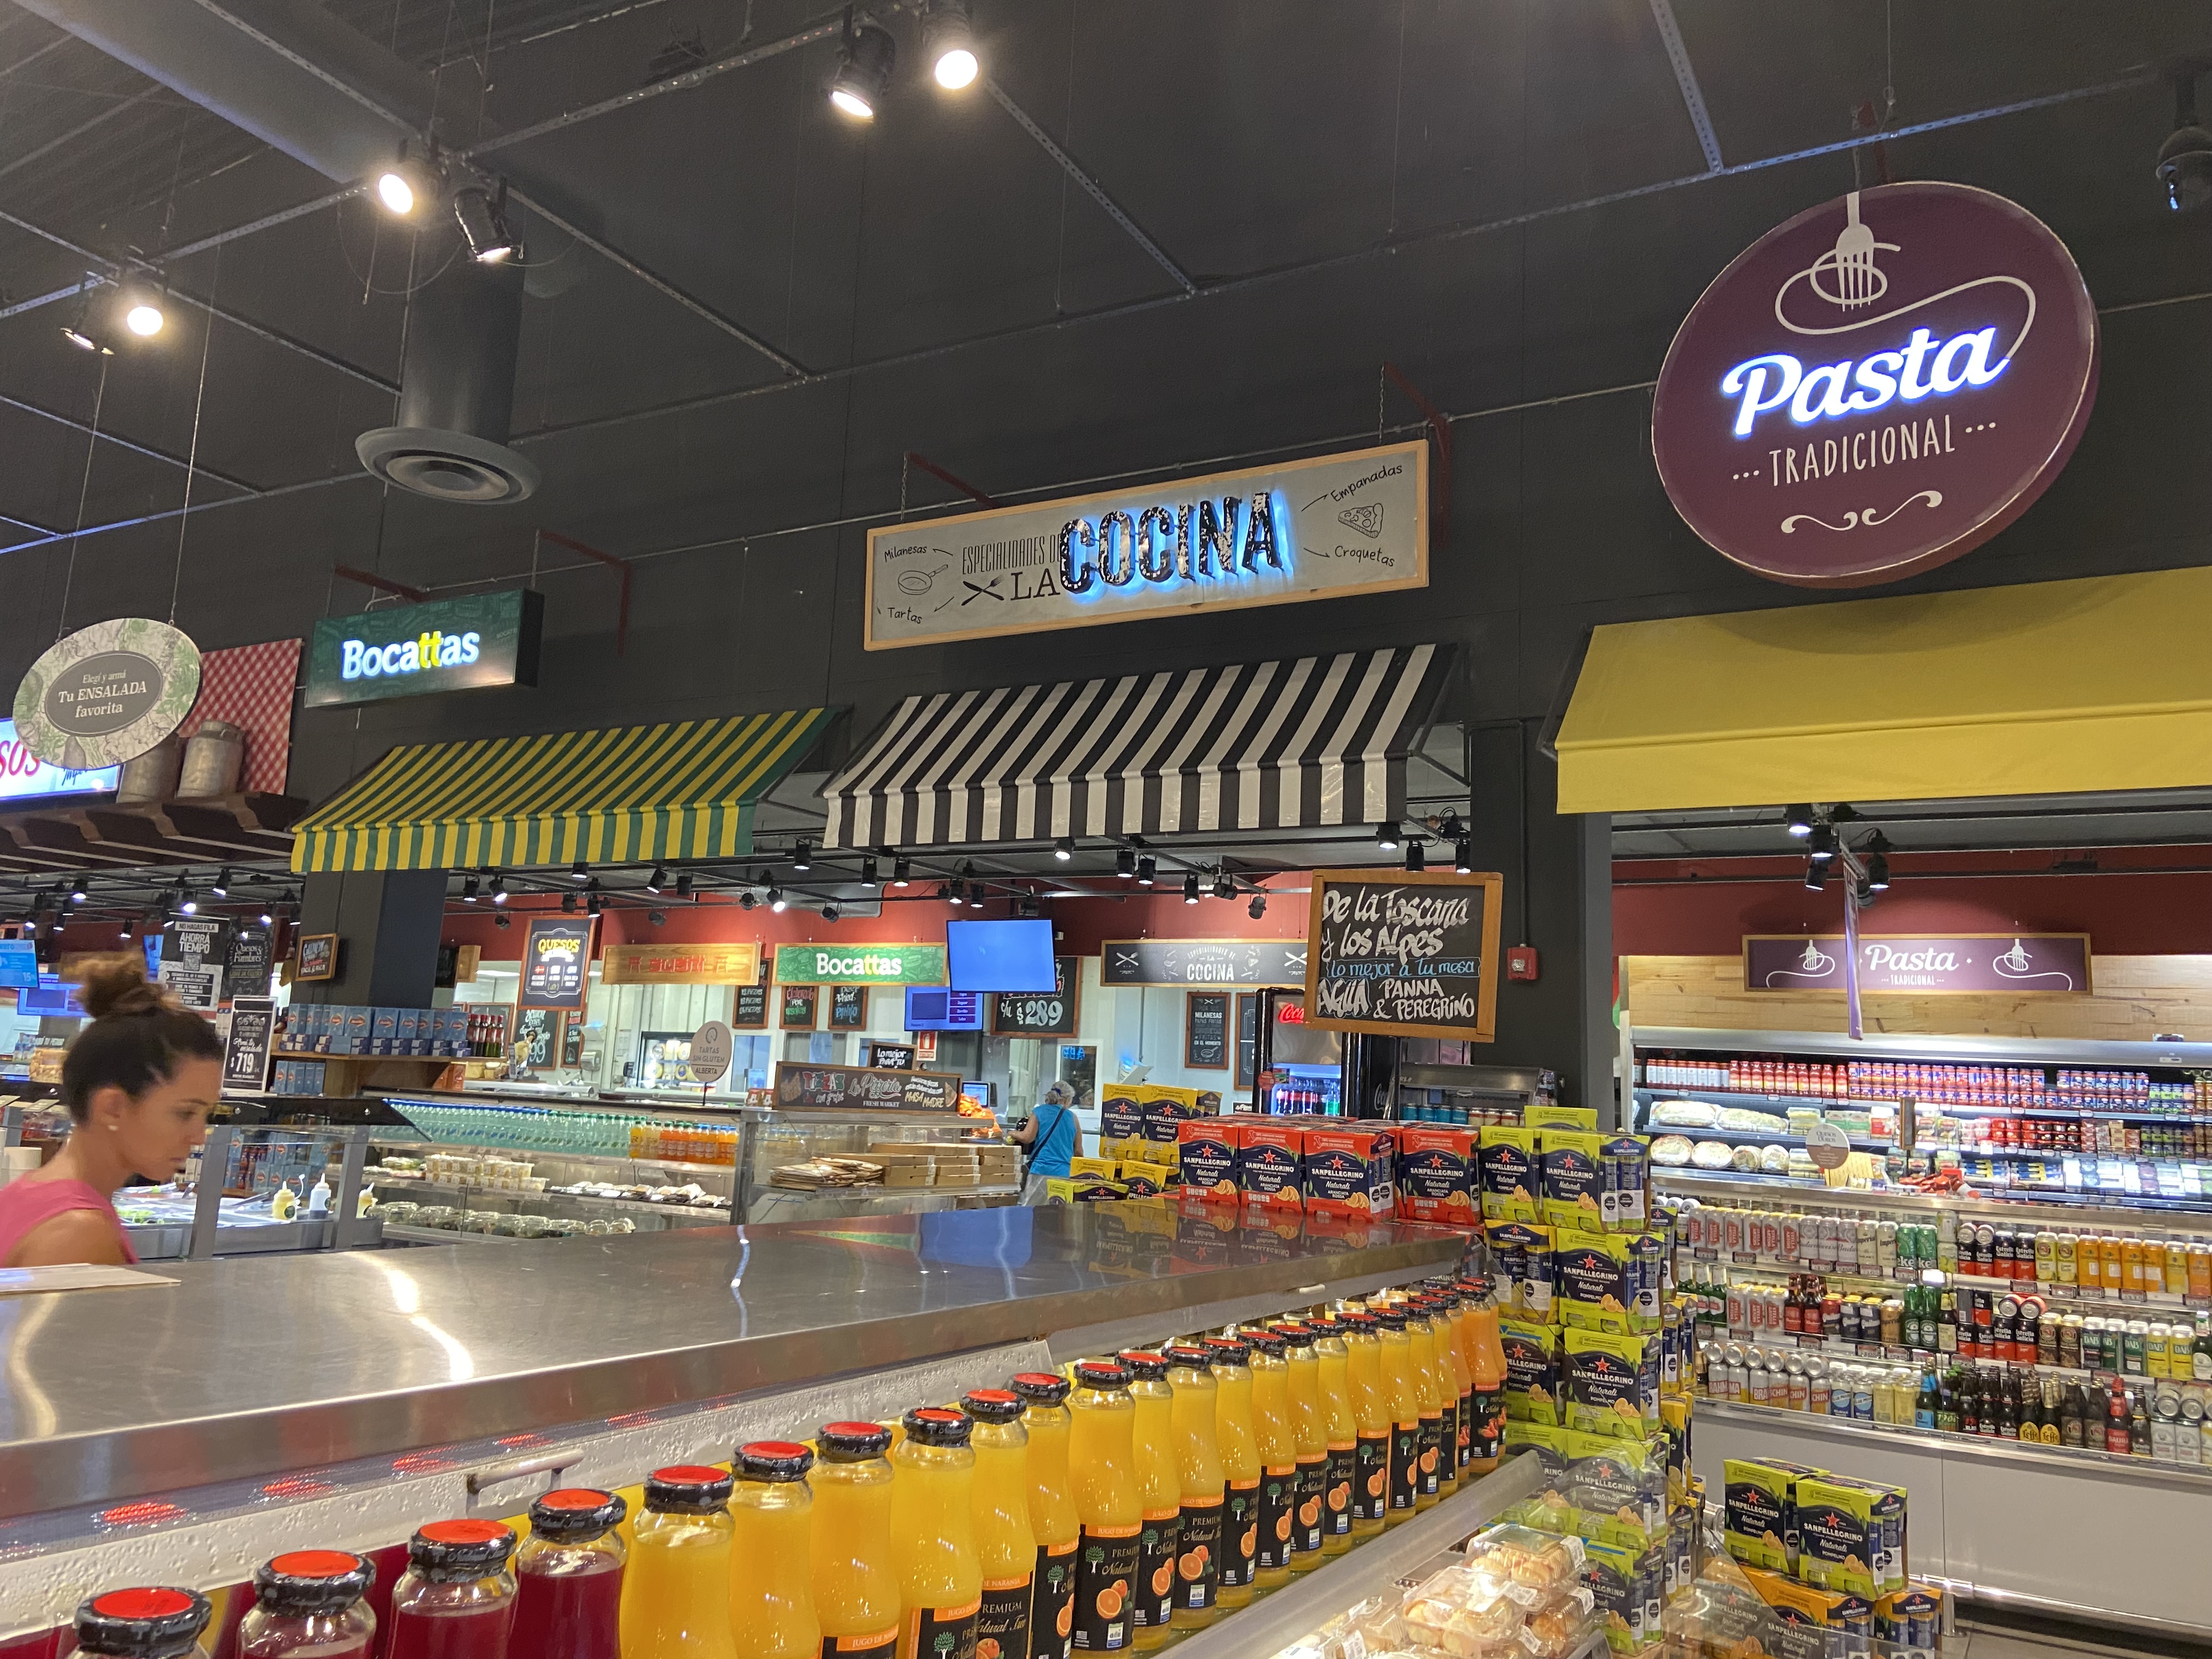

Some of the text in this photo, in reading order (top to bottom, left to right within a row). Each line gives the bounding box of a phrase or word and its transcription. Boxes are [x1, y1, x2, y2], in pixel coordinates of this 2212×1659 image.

[1723, 327, 2010, 436] Pasta
[1770, 414, 1955, 487] TRADICIONAL
[1330, 465, 1403, 502] Empanadas
[884, 546, 927, 562] Milanesas
[1011, 492, 1284, 601] LA COCINA
[963, 536, 1045, 575] ESPECIALIDADES
[1335, 545, 1395, 567] Croquetas
[887, 606, 922, 624] Tartas
[342, 630, 480, 679] Bocattas
[58, 681, 146, 703] Tu ENSALADA
[75, 703, 123, 718] favorita
[1322, 886, 1470, 929] De la Toscana
[179, 941, 210, 954] TIEMPO
[538, 939, 580, 954] QUESOS
[1187, 945, 1228, 959] ESPECIALIDADES
[1321, 923, 1444, 965] y los Alpes
[816, 952, 902, 976] Bocattas
[1865, 944, 1959, 971] Pasta
[1187, 963, 1234, 981] COCINA
[1350, 962, 1395, 980] mejor
[1399, 964, 1412, 976] a
[1438, 961, 1475, 974] mesa
[1891, 974, 1936, 985] TRADICIONAL
[1317, 979, 1444, 1019] AGUA PANNA
[1373, 1001, 1392, 1019] &
[230, 1052, 255, 1073] $ 719
[905, 1091, 945, 1108] MASA MADRE
[1104, 1112, 1141, 1121] SANPELLEGRINO
[1183, 1156, 1231, 1166] SANPELLEGRINO
[1245, 1162, 1294, 1172] SANPELLEGRINO
[1485, 1162, 1527, 1172] SANPELLEGRINO
[1311, 1168, 1364, 1178] SANPELLEGRINO
[1410, 1167, 1464, 1177] SANPELLEGRINO
[1546, 1167, 1594, 1180] SANPELLEGRINO
[1325, 1181, 1351, 1189] Naturali
[1564, 1266, 1618, 1281] SANPELLEGRINO
[1577, 1281, 1604, 1292] Naturali
[1572, 1369, 1634, 1385] SANPELLEGRINO
[1576, 1475, 1637, 1492] SANPELLEGRINO
[1729, 1499, 1779, 1518] SANPELLEGRINO
[1183, 1528, 1213, 1542] Natural
[1804, 1522, 1863, 1542] SANPELLEGRINO
[948, 1608, 964, 1619] JUGO
[853, 1637, 872, 1648] JUGO
[1768, 1622, 1819, 1646] SANPELLEGRINO
